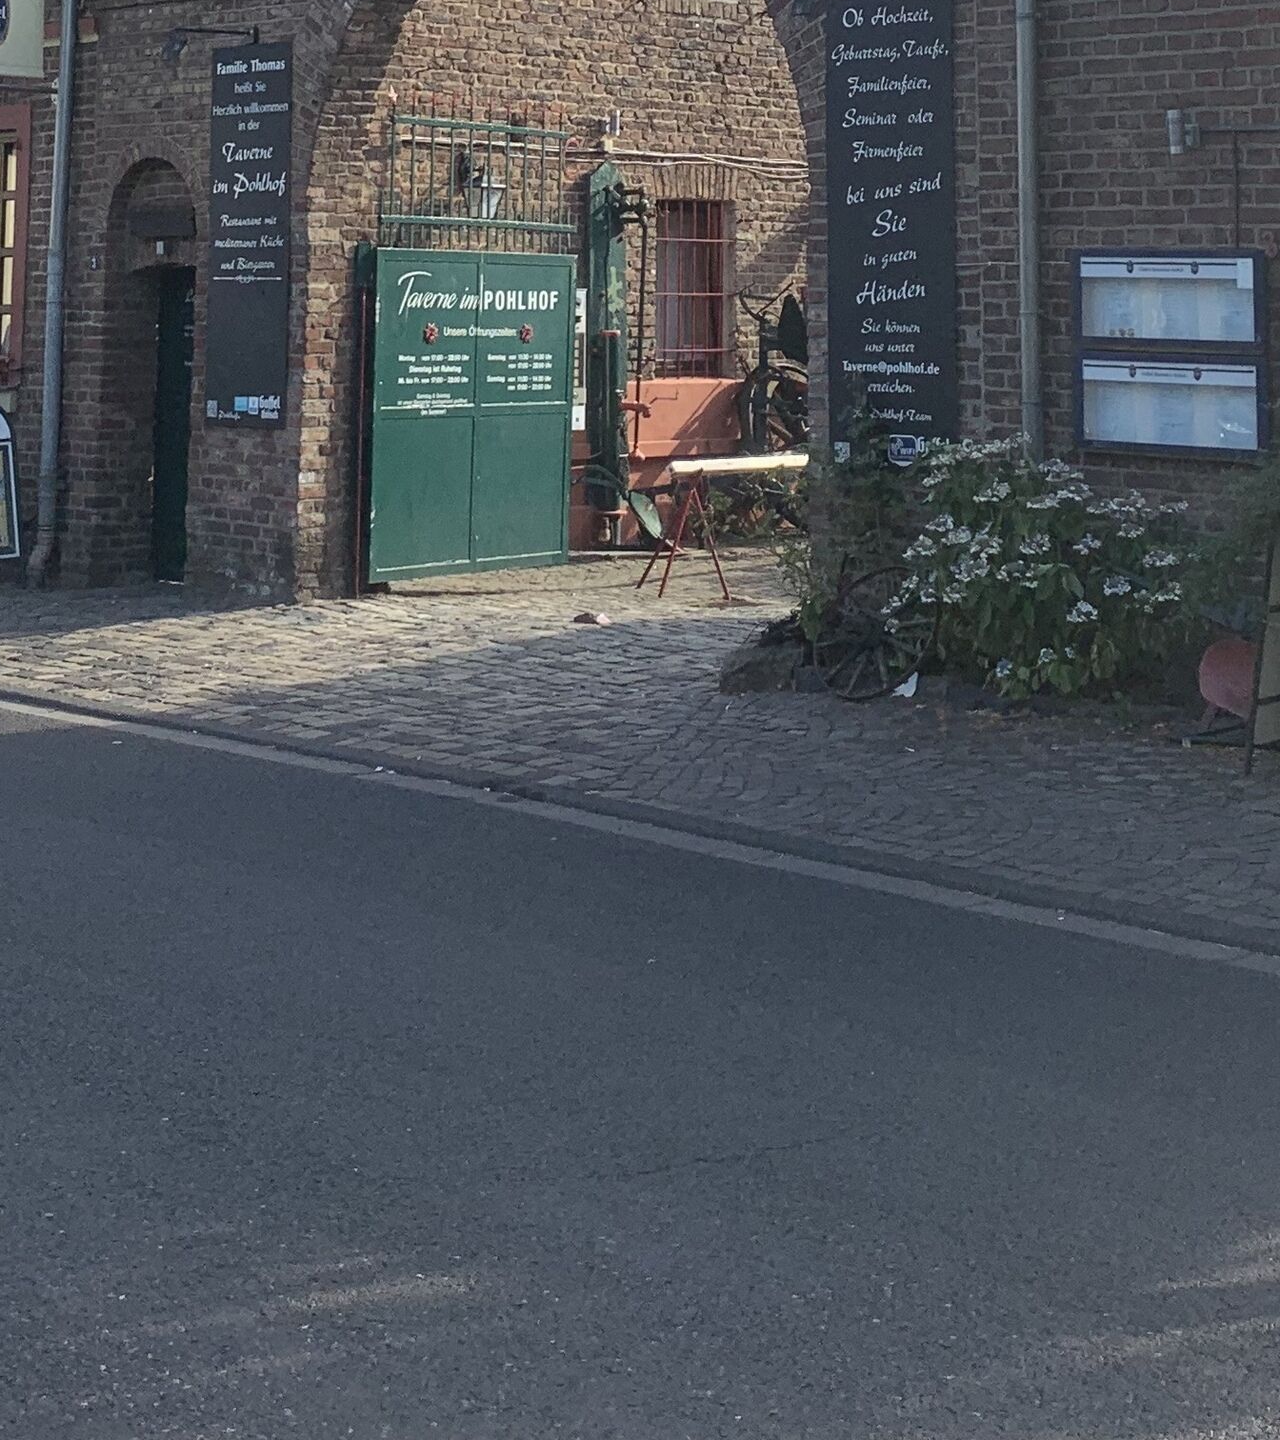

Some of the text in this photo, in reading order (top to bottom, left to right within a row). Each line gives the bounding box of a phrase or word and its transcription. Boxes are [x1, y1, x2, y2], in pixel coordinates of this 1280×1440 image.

[842, 5, 934, 28] Ob Hochzeit,
[831, 38, 949, 67] Geburtstag, Taufe,
[216, 58, 286, 76] Familie Thomas
[255, 80, 267, 93] Sie
[847, 73, 931, 98] Familienfeier,
[212, 102, 289, 116] Herzlich willkommen
[842, 107, 934, 128] Seminar oder
[238, 119, 261, 131] in der
[222, 142, 274, 163] Taverne
[851, 140, 924, 163] Firmenfeier
[213, 171, 287, 199] im Pohlhof
[846, 171, 942, 205] bei uns sind
[871, 209, 908, 237] Sie
[863, 249, 918, 270] in guten
[397, 270, 559, 316] Taverne im POHLHOF
[856, 280, 926, 305] Händen
[443, 326, 468, 337] Unsere
[861, 318, 921, 334] Sie können
[864, 343, 915, 353] uns unter
[842, 360, 940, 375] Taverne@pohlhof.de
[867, 378, 916, 393] erreichen.
